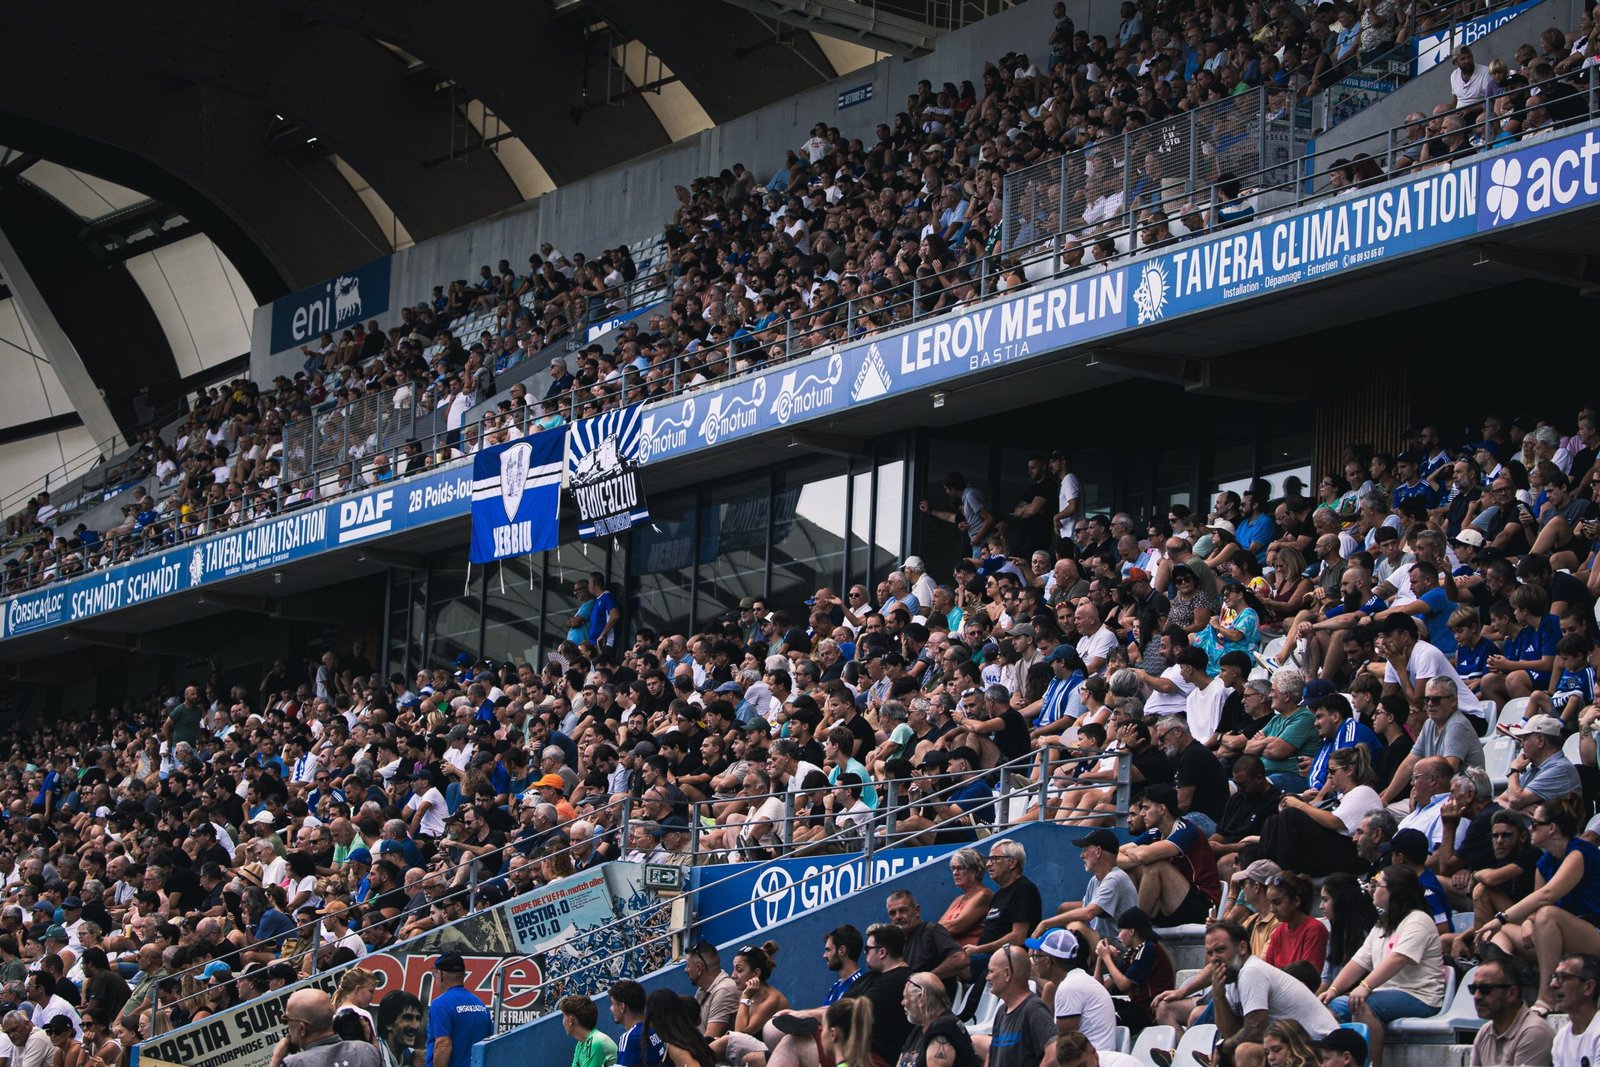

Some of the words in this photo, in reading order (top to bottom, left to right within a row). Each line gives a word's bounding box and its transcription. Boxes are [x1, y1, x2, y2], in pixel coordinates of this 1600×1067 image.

[1526, 132, 1600, 212] act
[1173, 235, 1264, 298] TAVERA
[1271, 166, 1477, 271] CLIMATISATION
[1223, 282, 1259, 298] Installation
[1264, 270, 1301, 288] Dépannage
[1307, 259, 1338, 277] Entretien
[292, 282, 332, 341] eni
[901, 309, 993, 375] LEROY
[999, 271, 1124, 344] MERLIN
[851, 351, 871, 401] LEROY
[869, 342, 892, 391] MERLIN
[969, 341, 1030, 370] BASTIA
[339, 490, 394, 529] DAF
[408, 489, 422, 513] 2B
[205, 533, 243, 573] TAVERA
[245, 508, 327, 562] CLIMATISATION
[8, 598, 46, 635] CORSICA
[511, 899, 532, 914] COUPE
[532, 897, 541, 907] DE
[568, 882, 589, 895] match
[353, 953, 543, 1010] onze
[508, 1010, 540, 1024] FRANCE
[265, 1032, 280, 1046] DU
